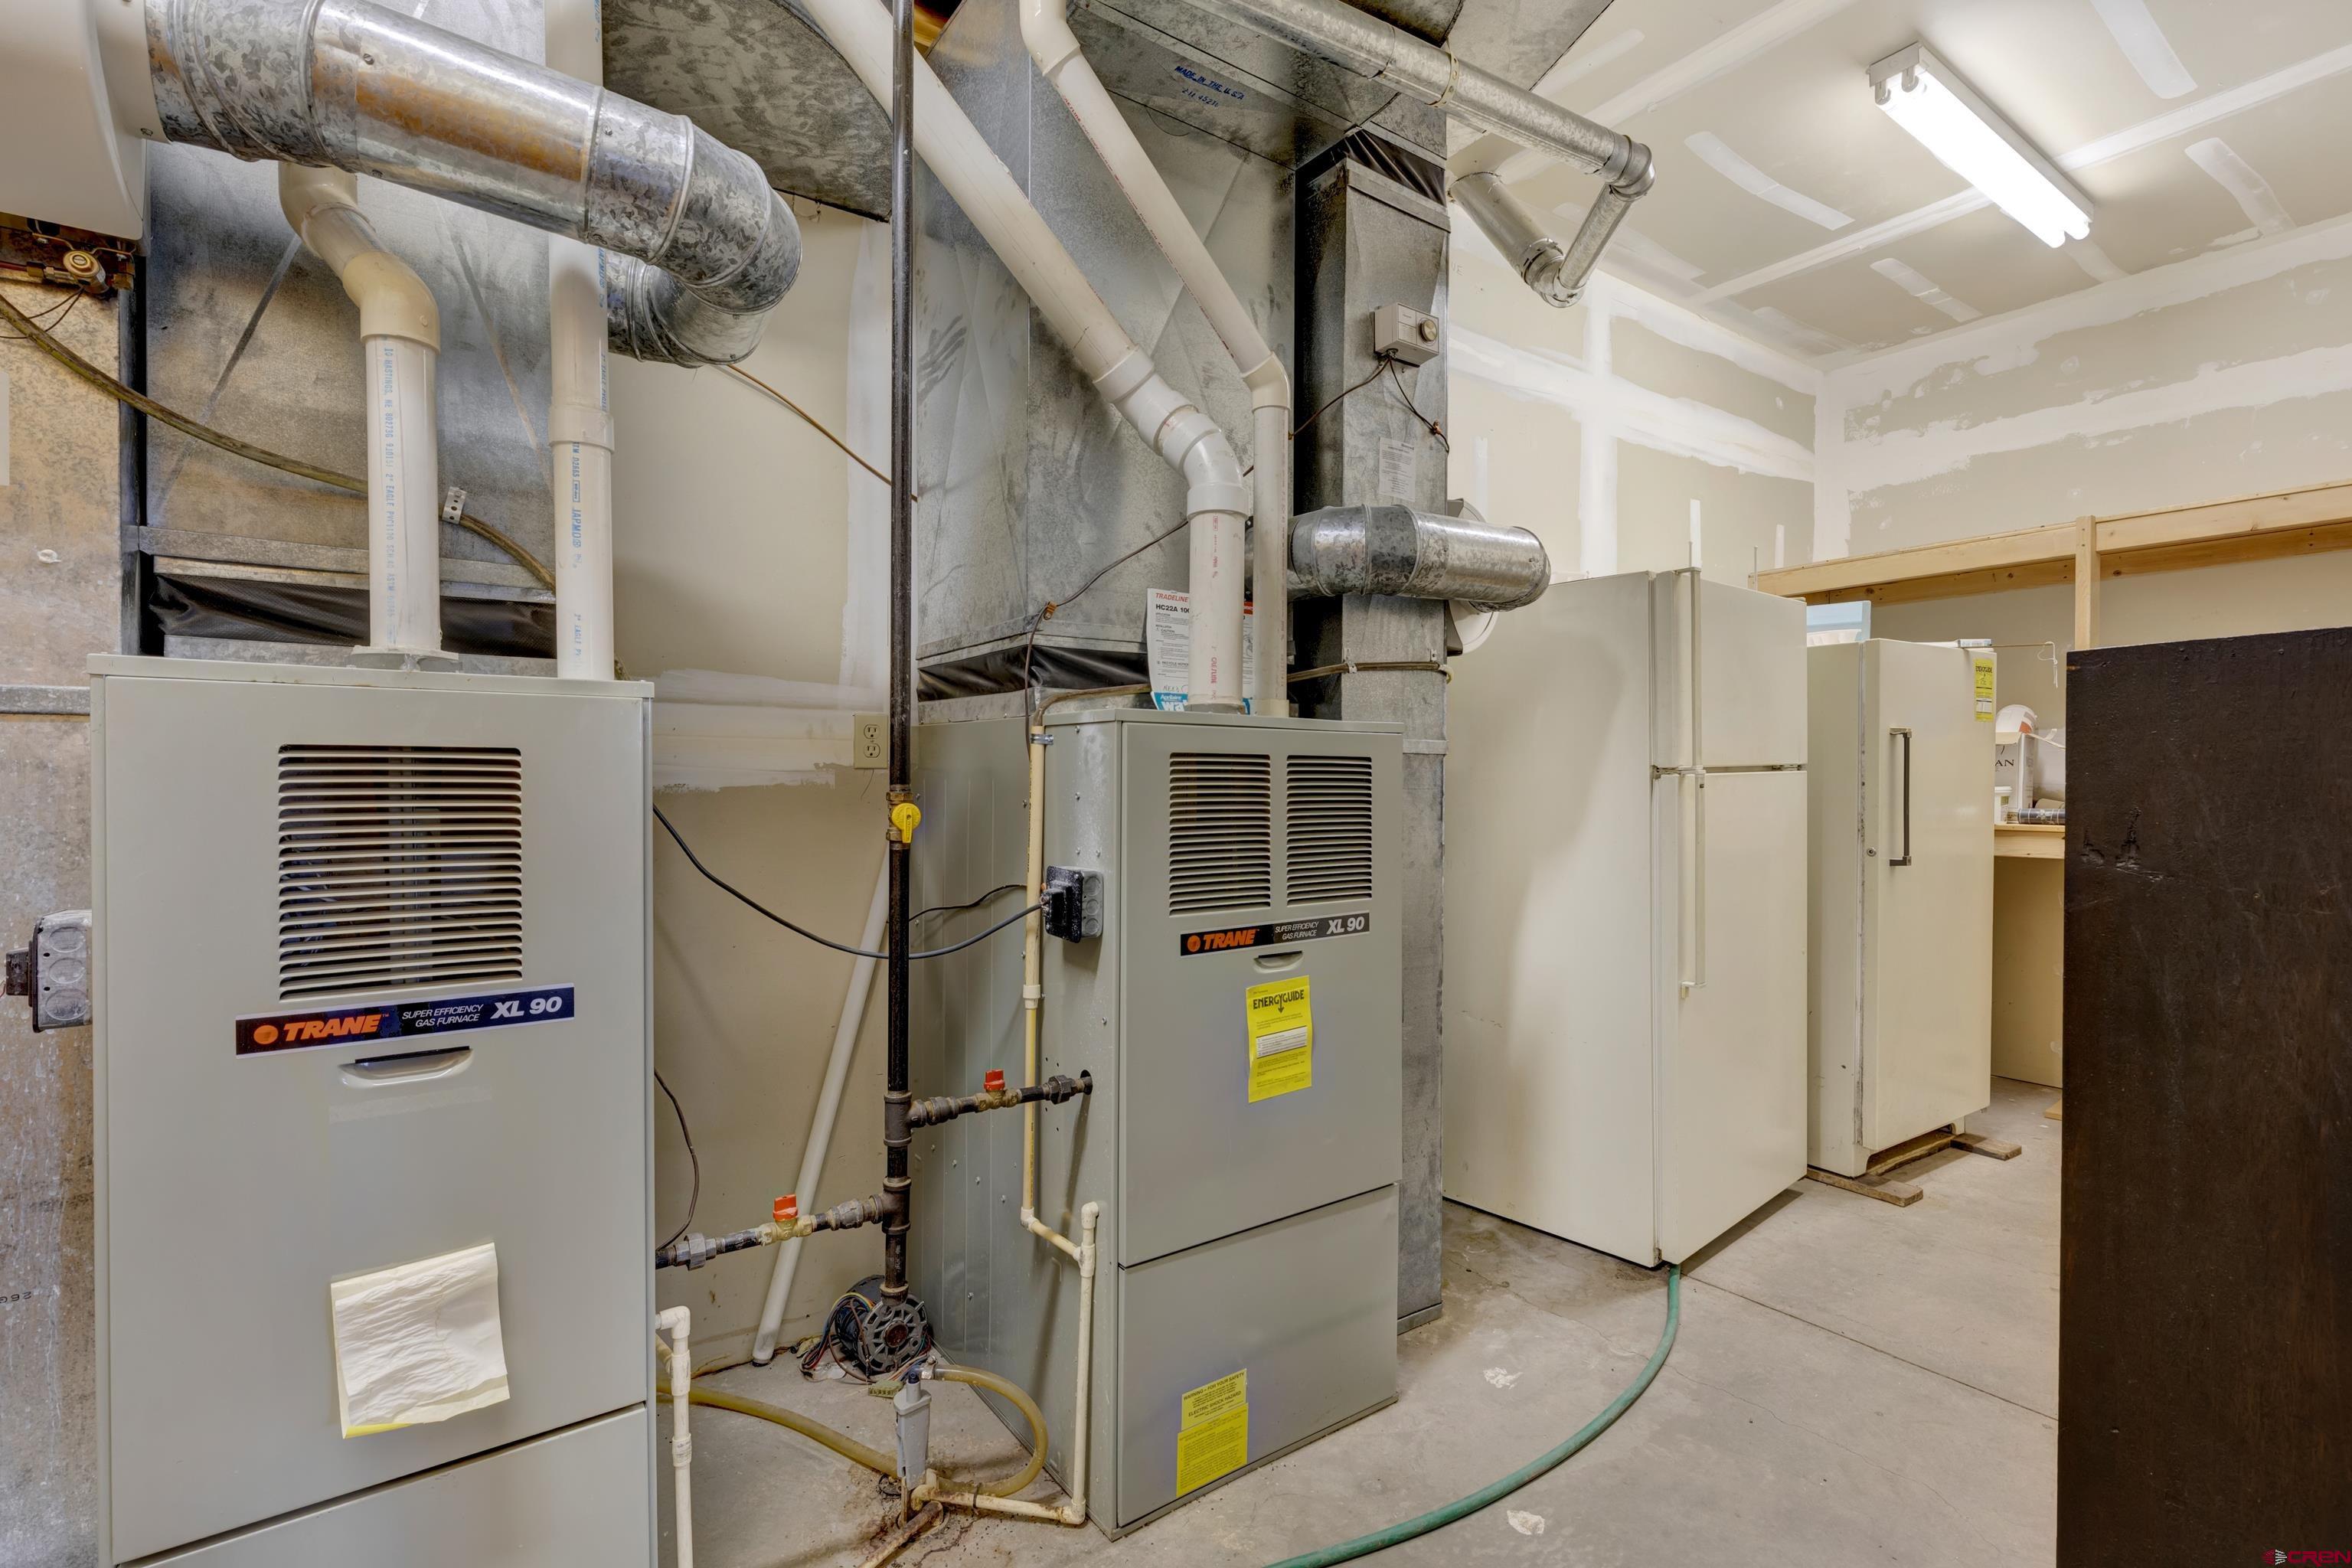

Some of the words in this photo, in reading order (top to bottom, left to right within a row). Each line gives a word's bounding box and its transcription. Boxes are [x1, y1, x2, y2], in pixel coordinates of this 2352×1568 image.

[1174, 66, 1197, 80] MADE
[1209, 80, 1223, 91] THE
[386, 485, 395, 507] EAGLE
[1155, 593, 1189, 603] TRADELINE
[1155, 604, 1178, 612] HC22A
[1275, 925, 1292, 933] SUPER
[1292, 922, 1319, 931] EFFICIENCY
[1282, 932, 1294, 940] GAS
[1294, 929, 1318, 939] FURNACE
[1327, 919, 1345, 935] XL
[1348, 916, 1365, 932] 90
[1204, 929, 1256, 950] TRANE
[490, 1001, 526, 1020] XL
[529, 996, 563, 1015] 90
[1253, 989, 1305, 1010] ENERGYGUIDE
[402, 1009, 433, 1021] SUPER
[433, 1003, 484, 1018] EFFICIENCY
[415, 1015, 436, 1028] GAS
[438, 1011, 480, 1027] FURNACE
[283, 1014, 384, 1042] TRANE
[1184, 1390, 1204, 1400] WARNING
[1217, 1379, 1229, 1388] YOUR
[1228, 1371, 1245, 1383] SAFETY
[1188, 1406, 1209, 1417] ELECTRIC
[1209, 1399, 1224, 1410] SHOCK
